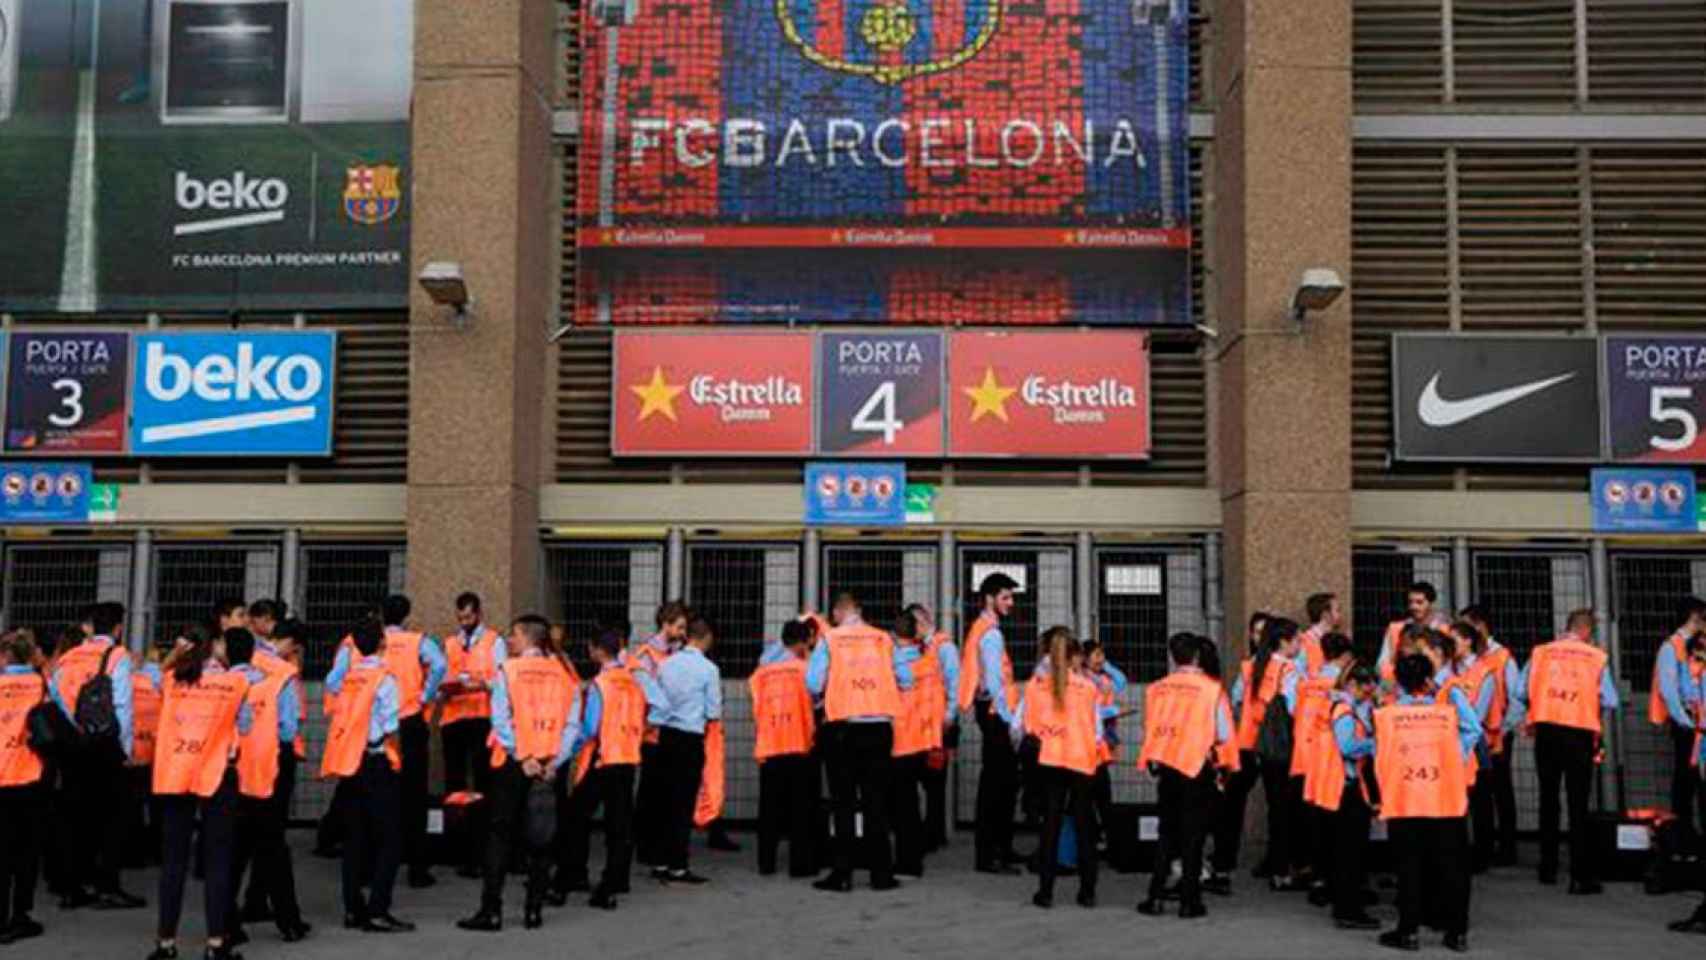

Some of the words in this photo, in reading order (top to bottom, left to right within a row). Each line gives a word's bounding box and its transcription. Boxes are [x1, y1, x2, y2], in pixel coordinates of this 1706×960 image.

[175, 171, 289, 210] beko
[172, 254, 190, 266] FC
[192, 253, 273, 266] BARCELONA
[275, 253, 336, 265] PREMIUM
[338, 251, 401, 264] PARTNER
[26, 340, 110, 362] PORTA
[839, 341, 922, 363] PORTA
[1626, 346, 1706, 369] PORTA
[145, 342, 322, 402] beko
[48, 379, 83, 427] 3
[690, 375, 802, 406] Estrella
[1022, 376, 1136, 407] Estrella
[851, 381, 903, 444] 4
[1649, 387, 1697, 451] 5
[1402, 766, 1440, 782] 243
